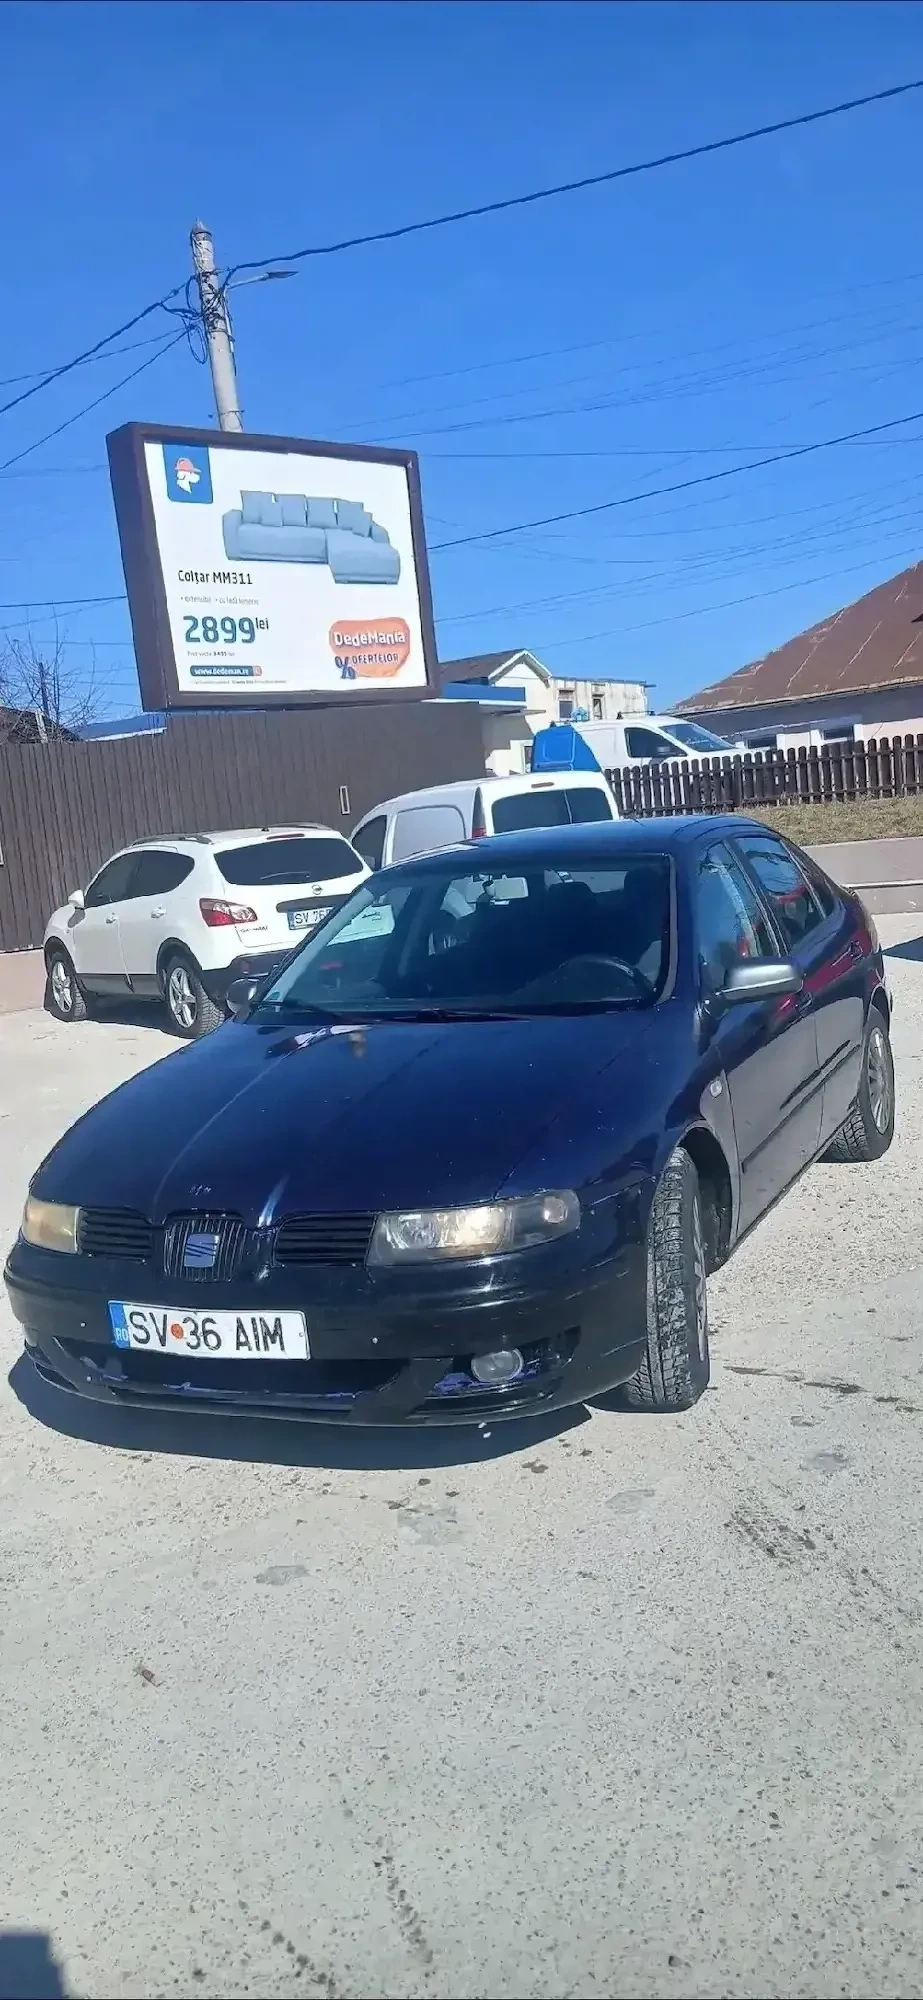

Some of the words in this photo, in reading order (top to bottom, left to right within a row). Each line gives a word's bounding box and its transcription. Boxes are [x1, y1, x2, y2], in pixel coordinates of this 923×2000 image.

[178, 570, 210, 584] Colțar
[213, 571, 253, 585] MM311
[183, 615, 256, 644] 2899
[255, 617, 269, 630] lei
[333, 630, 406, 647] DedeMania
[352, 653, 399, 664] OFERTELOR
[295, 912, 309, 924] SV
[115, 1328, 129, 1342] RO
[129, 1311, 168, 1346] SV
[183, 1316, 222, 1351] 36
[235, 1317, 286, 1352] AIM
